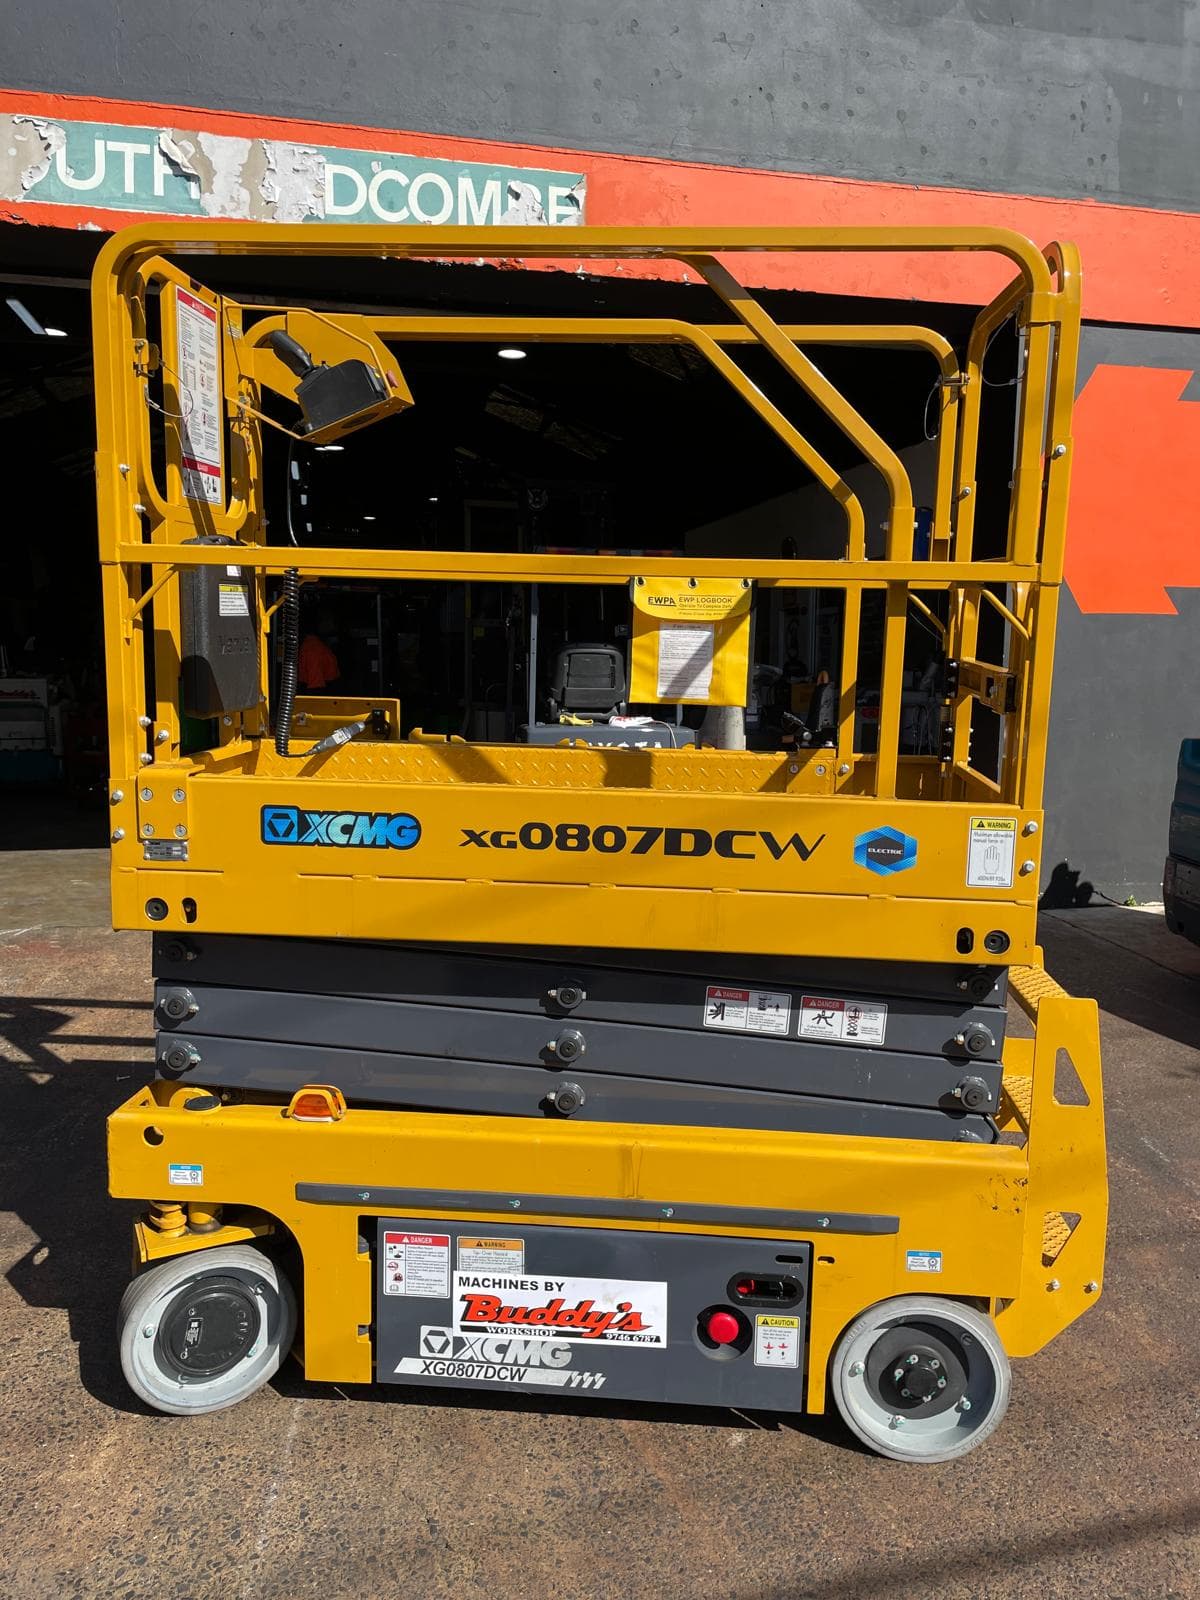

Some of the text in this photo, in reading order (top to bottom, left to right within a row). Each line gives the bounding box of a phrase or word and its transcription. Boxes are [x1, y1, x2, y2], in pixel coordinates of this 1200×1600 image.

[299, 811, 421, 850] XCMG
[459, 822, 826, 861] XG0807DCW
[867, 847, 904, 855] ELECTRIC
[722, 991, 743, 1000] DANGER
[816, 1000, 840, 1009] DANGER
[410, 1236, 433, 1245] DANGER
[458, 1276, 566, 1292] MACHINES BY
[460, 1293, 654, 1339] Buddy's
[770, 1318, 795, 1326] CAUTION
[486, 1325, 557, 1337] WORKSHOP
[606, 1332, 657, 1344] 9746 6787
[452, 1336, 573, 1368] XCMG
[420, 1359, 529, 1382] XG0807DCW
